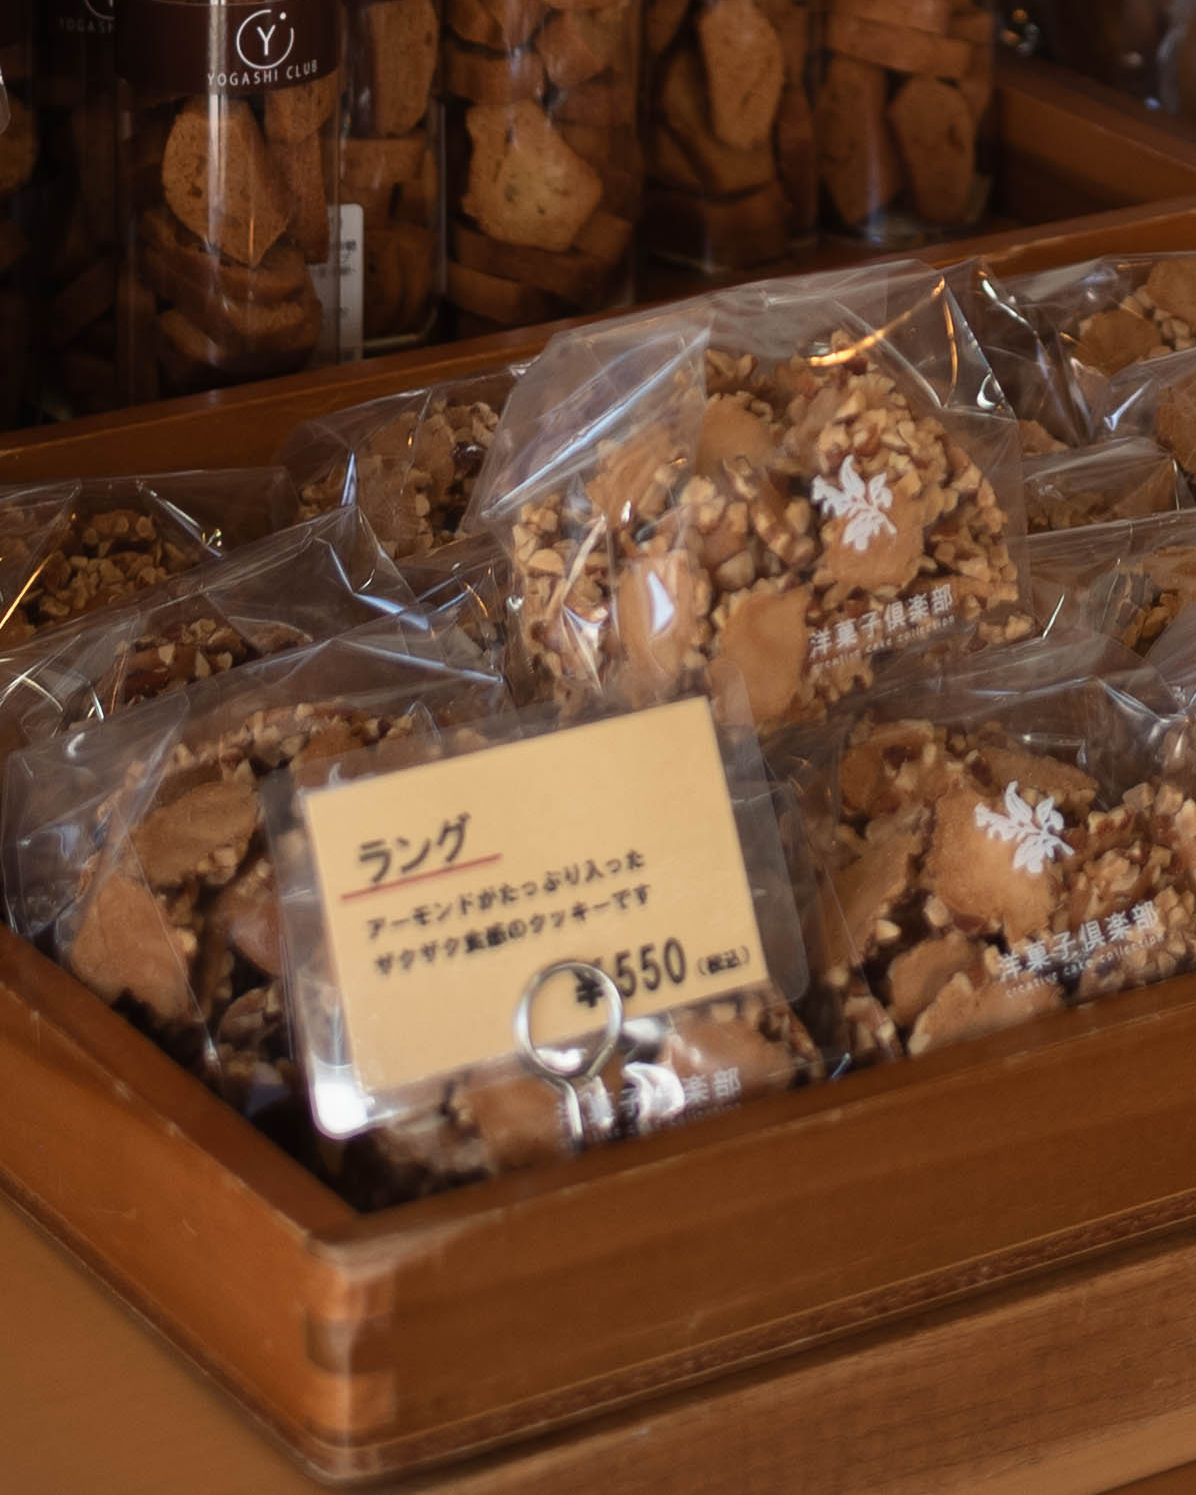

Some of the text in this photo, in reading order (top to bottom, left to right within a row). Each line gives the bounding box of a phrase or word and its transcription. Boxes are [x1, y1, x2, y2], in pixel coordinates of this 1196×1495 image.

[207, 58, 318, 88] YOGASHI CLUB
[809, 583, 953, 659] 洋菓子倶楽部
[358, 811, 472, 885] ラング
[999, 900, 1160, 982] 洋菓子倶楽部
